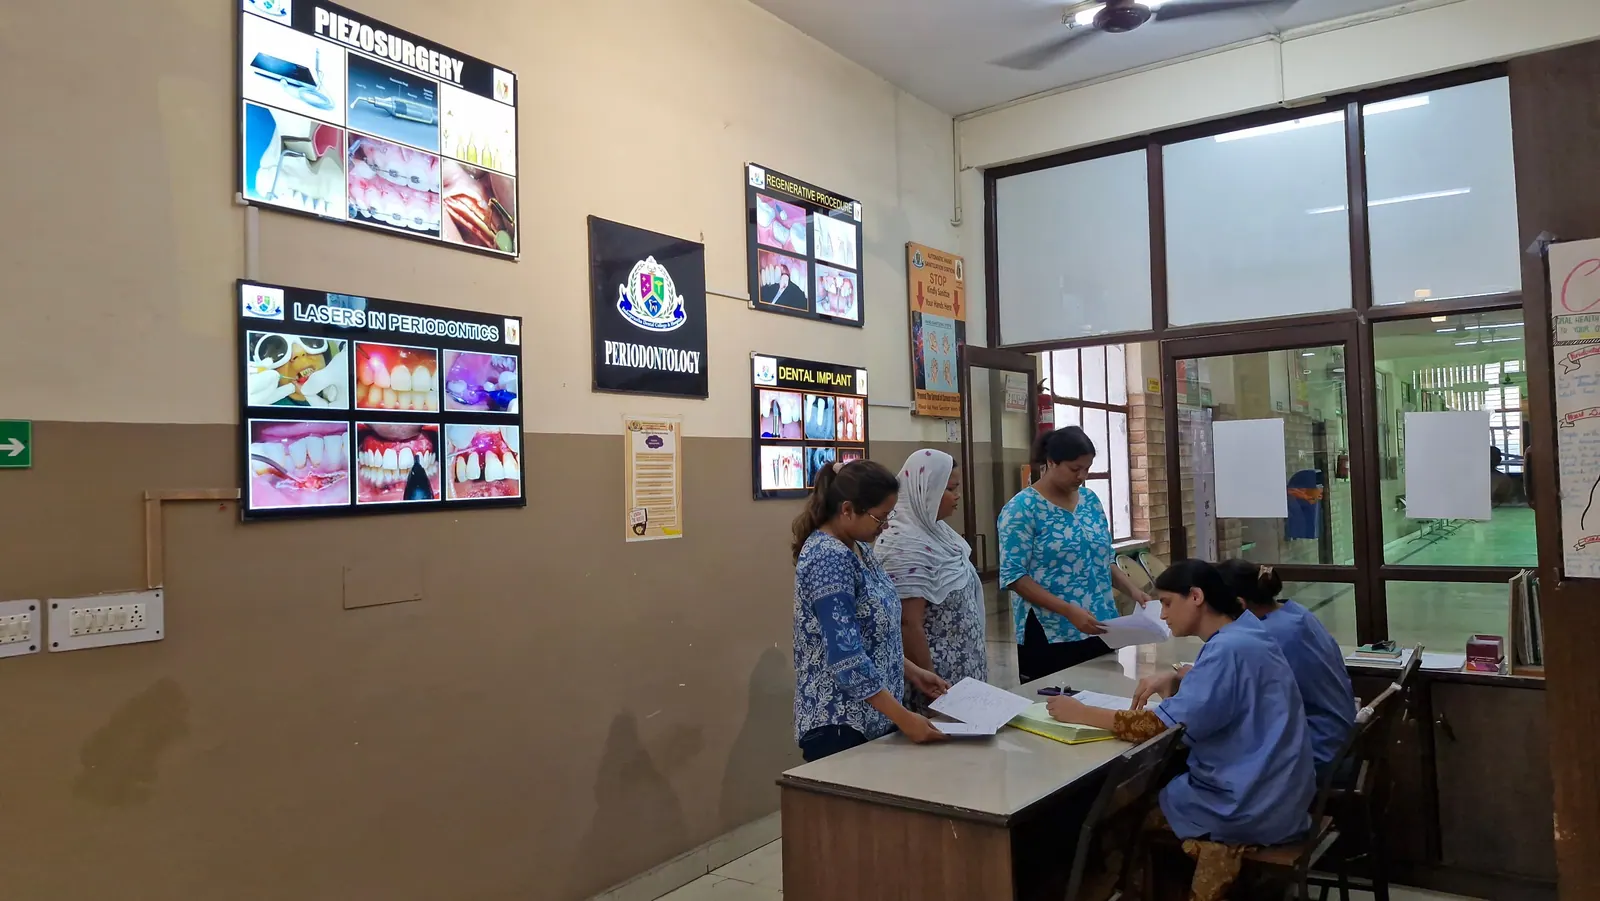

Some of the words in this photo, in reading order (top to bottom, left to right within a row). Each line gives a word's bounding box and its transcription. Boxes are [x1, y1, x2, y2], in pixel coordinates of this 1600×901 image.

[314, 6, 464, 84] PIEZOSURGERY
[766, 174, 816, 201] REGENERATIVE
[816, 192, 853, 214] PROCEDURE
[926, 285, 938, 297] Kindly
[929, 272, 947, 287] STOP
[925, 298, 934, 307] Your
[933, 300, 944, 310] Hands
[293, 303, 366, 328] LASERS
[368, 310, 387, 330] IN
[389, 313, 499, 342] PERIODONTICS
[604, 340, 700, 374] PERIODONTOLOGY
[778, 366, 814, 383] DENTAL
[816, 371, 852, 386] IMPLANT
